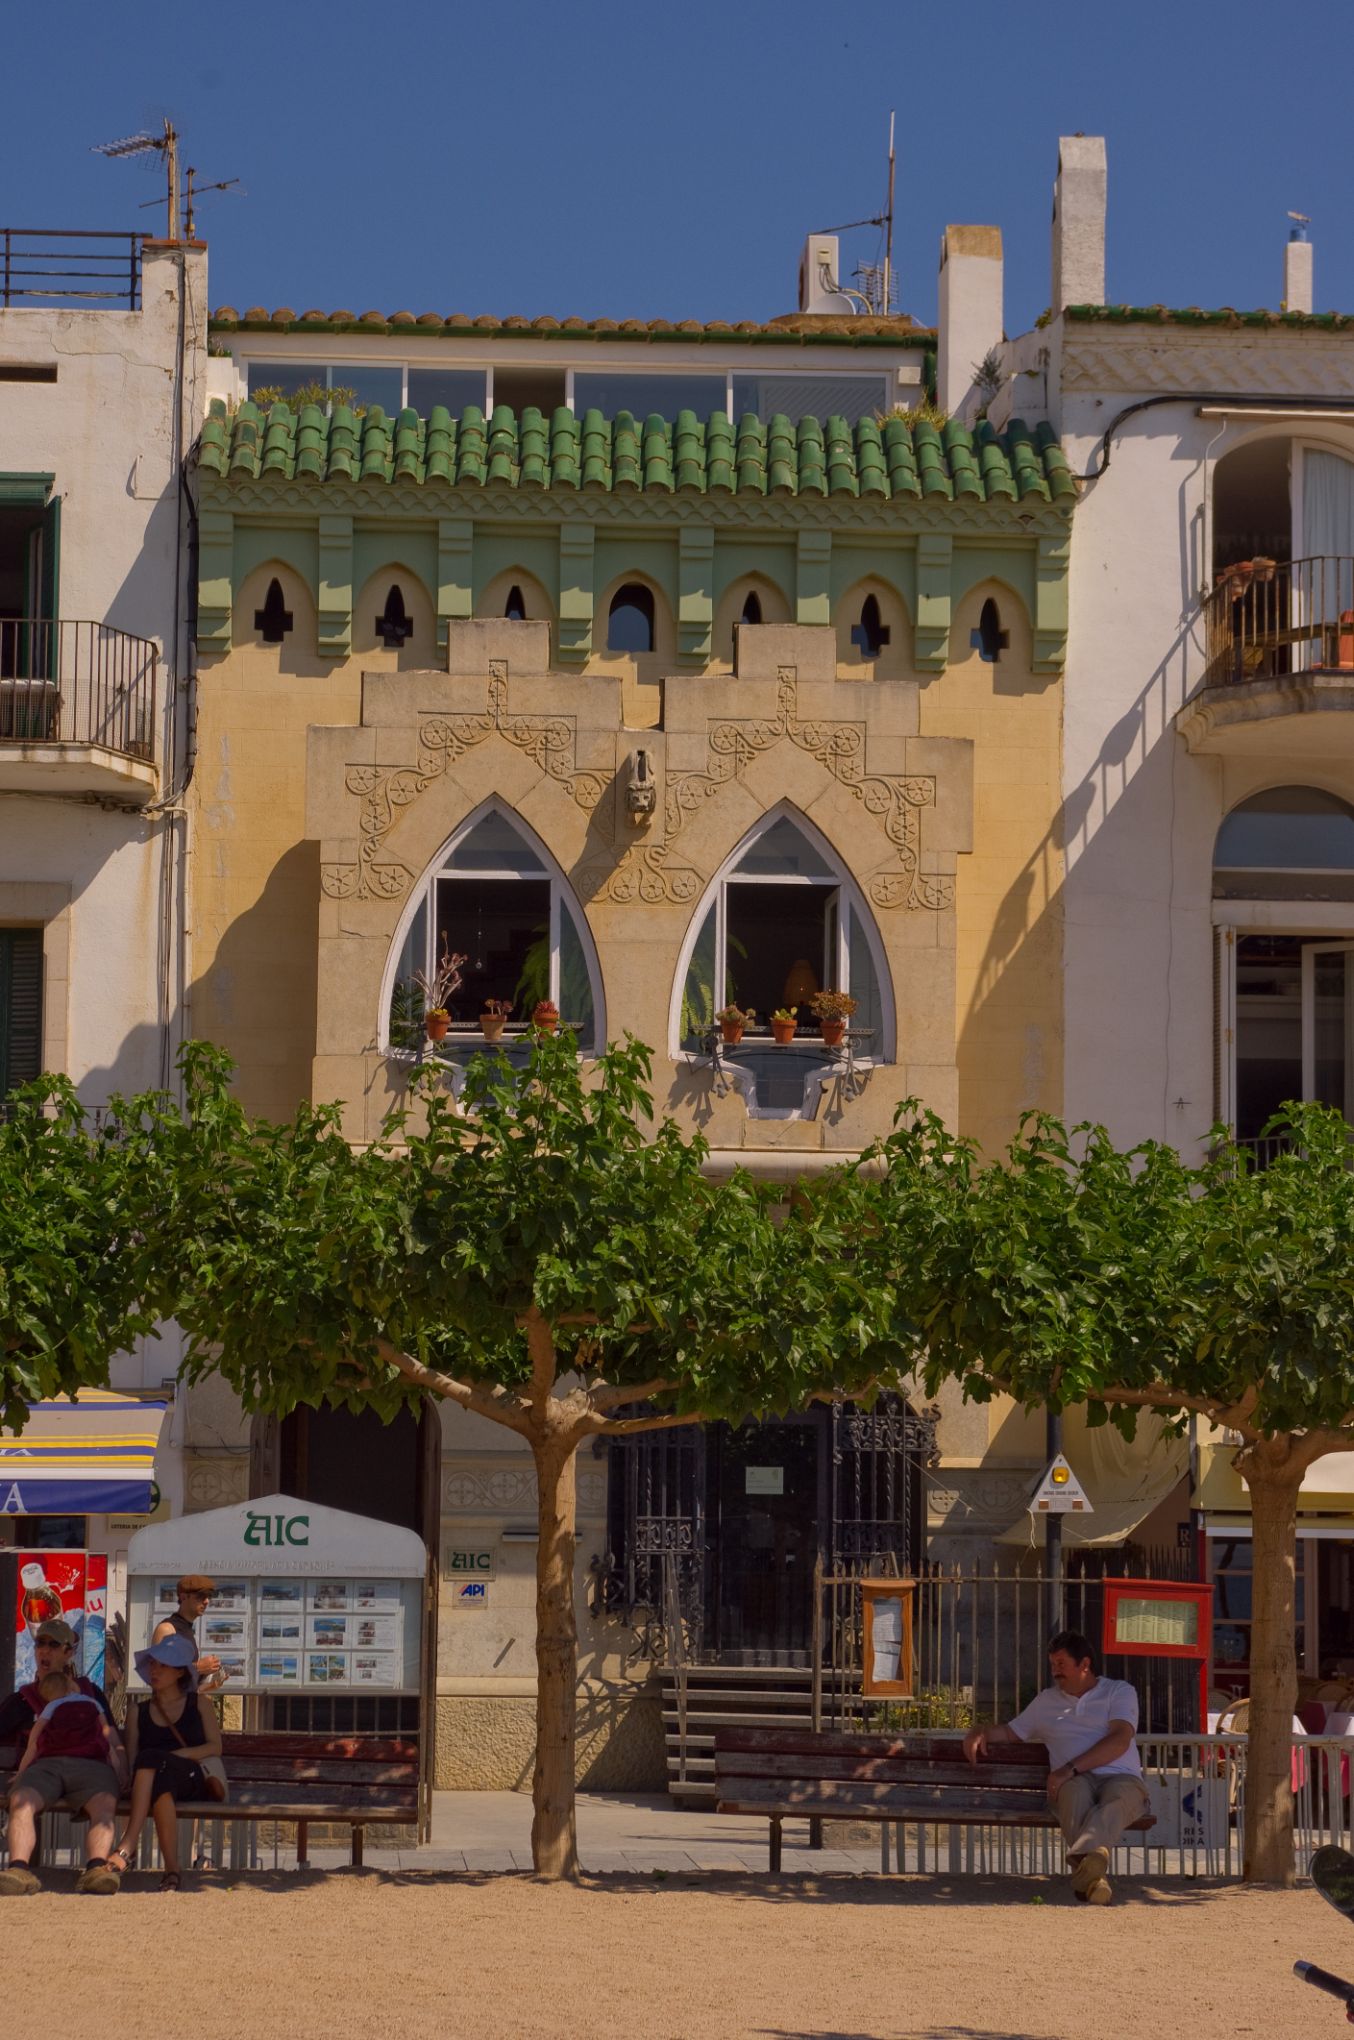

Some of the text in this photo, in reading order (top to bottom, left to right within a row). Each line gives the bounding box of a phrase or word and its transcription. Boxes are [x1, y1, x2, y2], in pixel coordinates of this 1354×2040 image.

[243, 1510, 310, 1546] AIC
[451, 1551, 490, 1569] AIC
[461, 1583, 485, 1597] API
